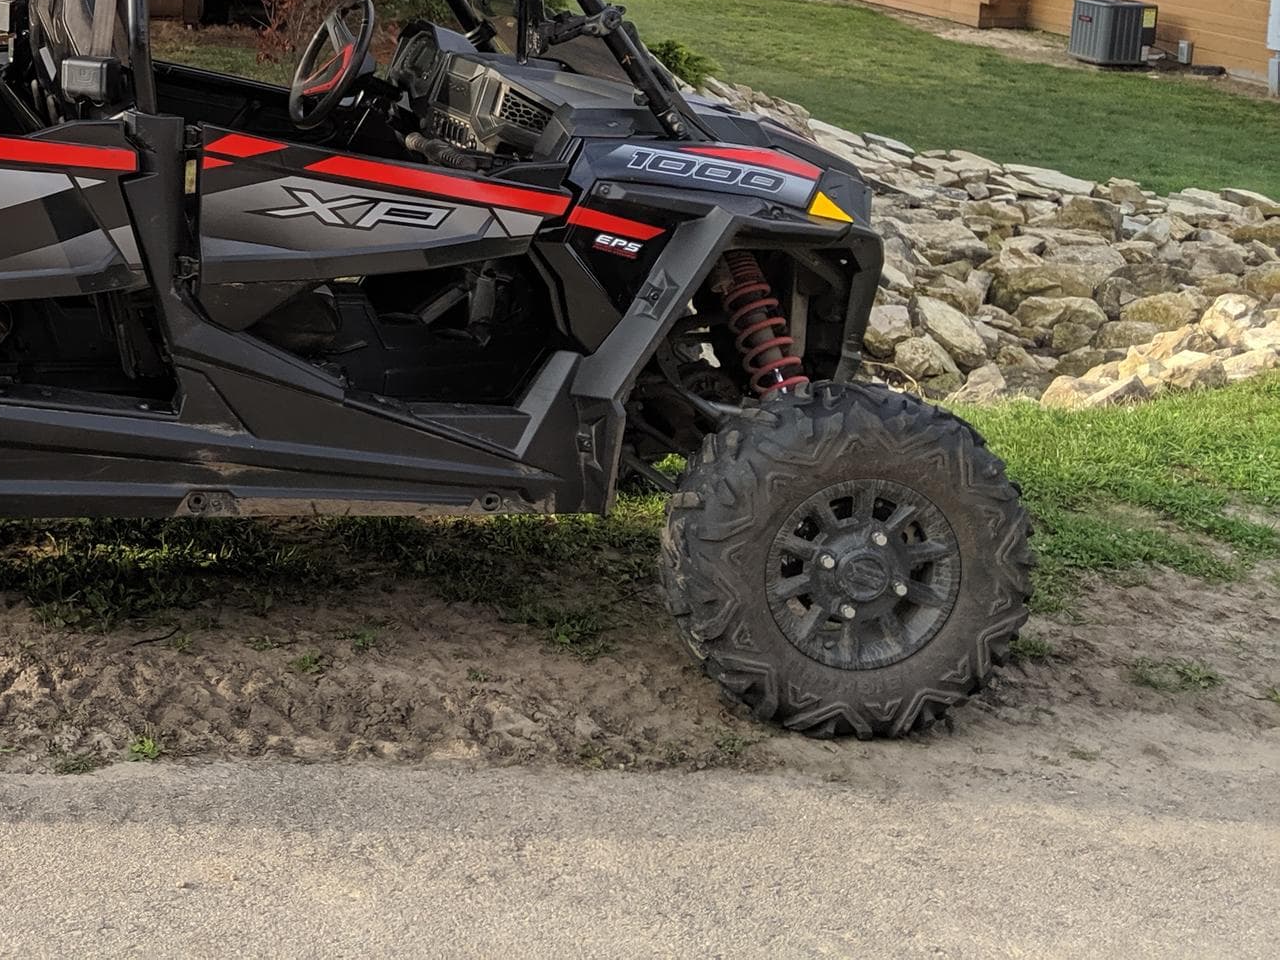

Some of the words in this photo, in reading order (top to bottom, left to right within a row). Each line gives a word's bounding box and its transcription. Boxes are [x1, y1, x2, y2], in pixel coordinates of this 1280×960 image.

[627, 150, 787, 193] 1000
[243, 185, 456, 231] XP
[595, 234, 644, 253] EPS
